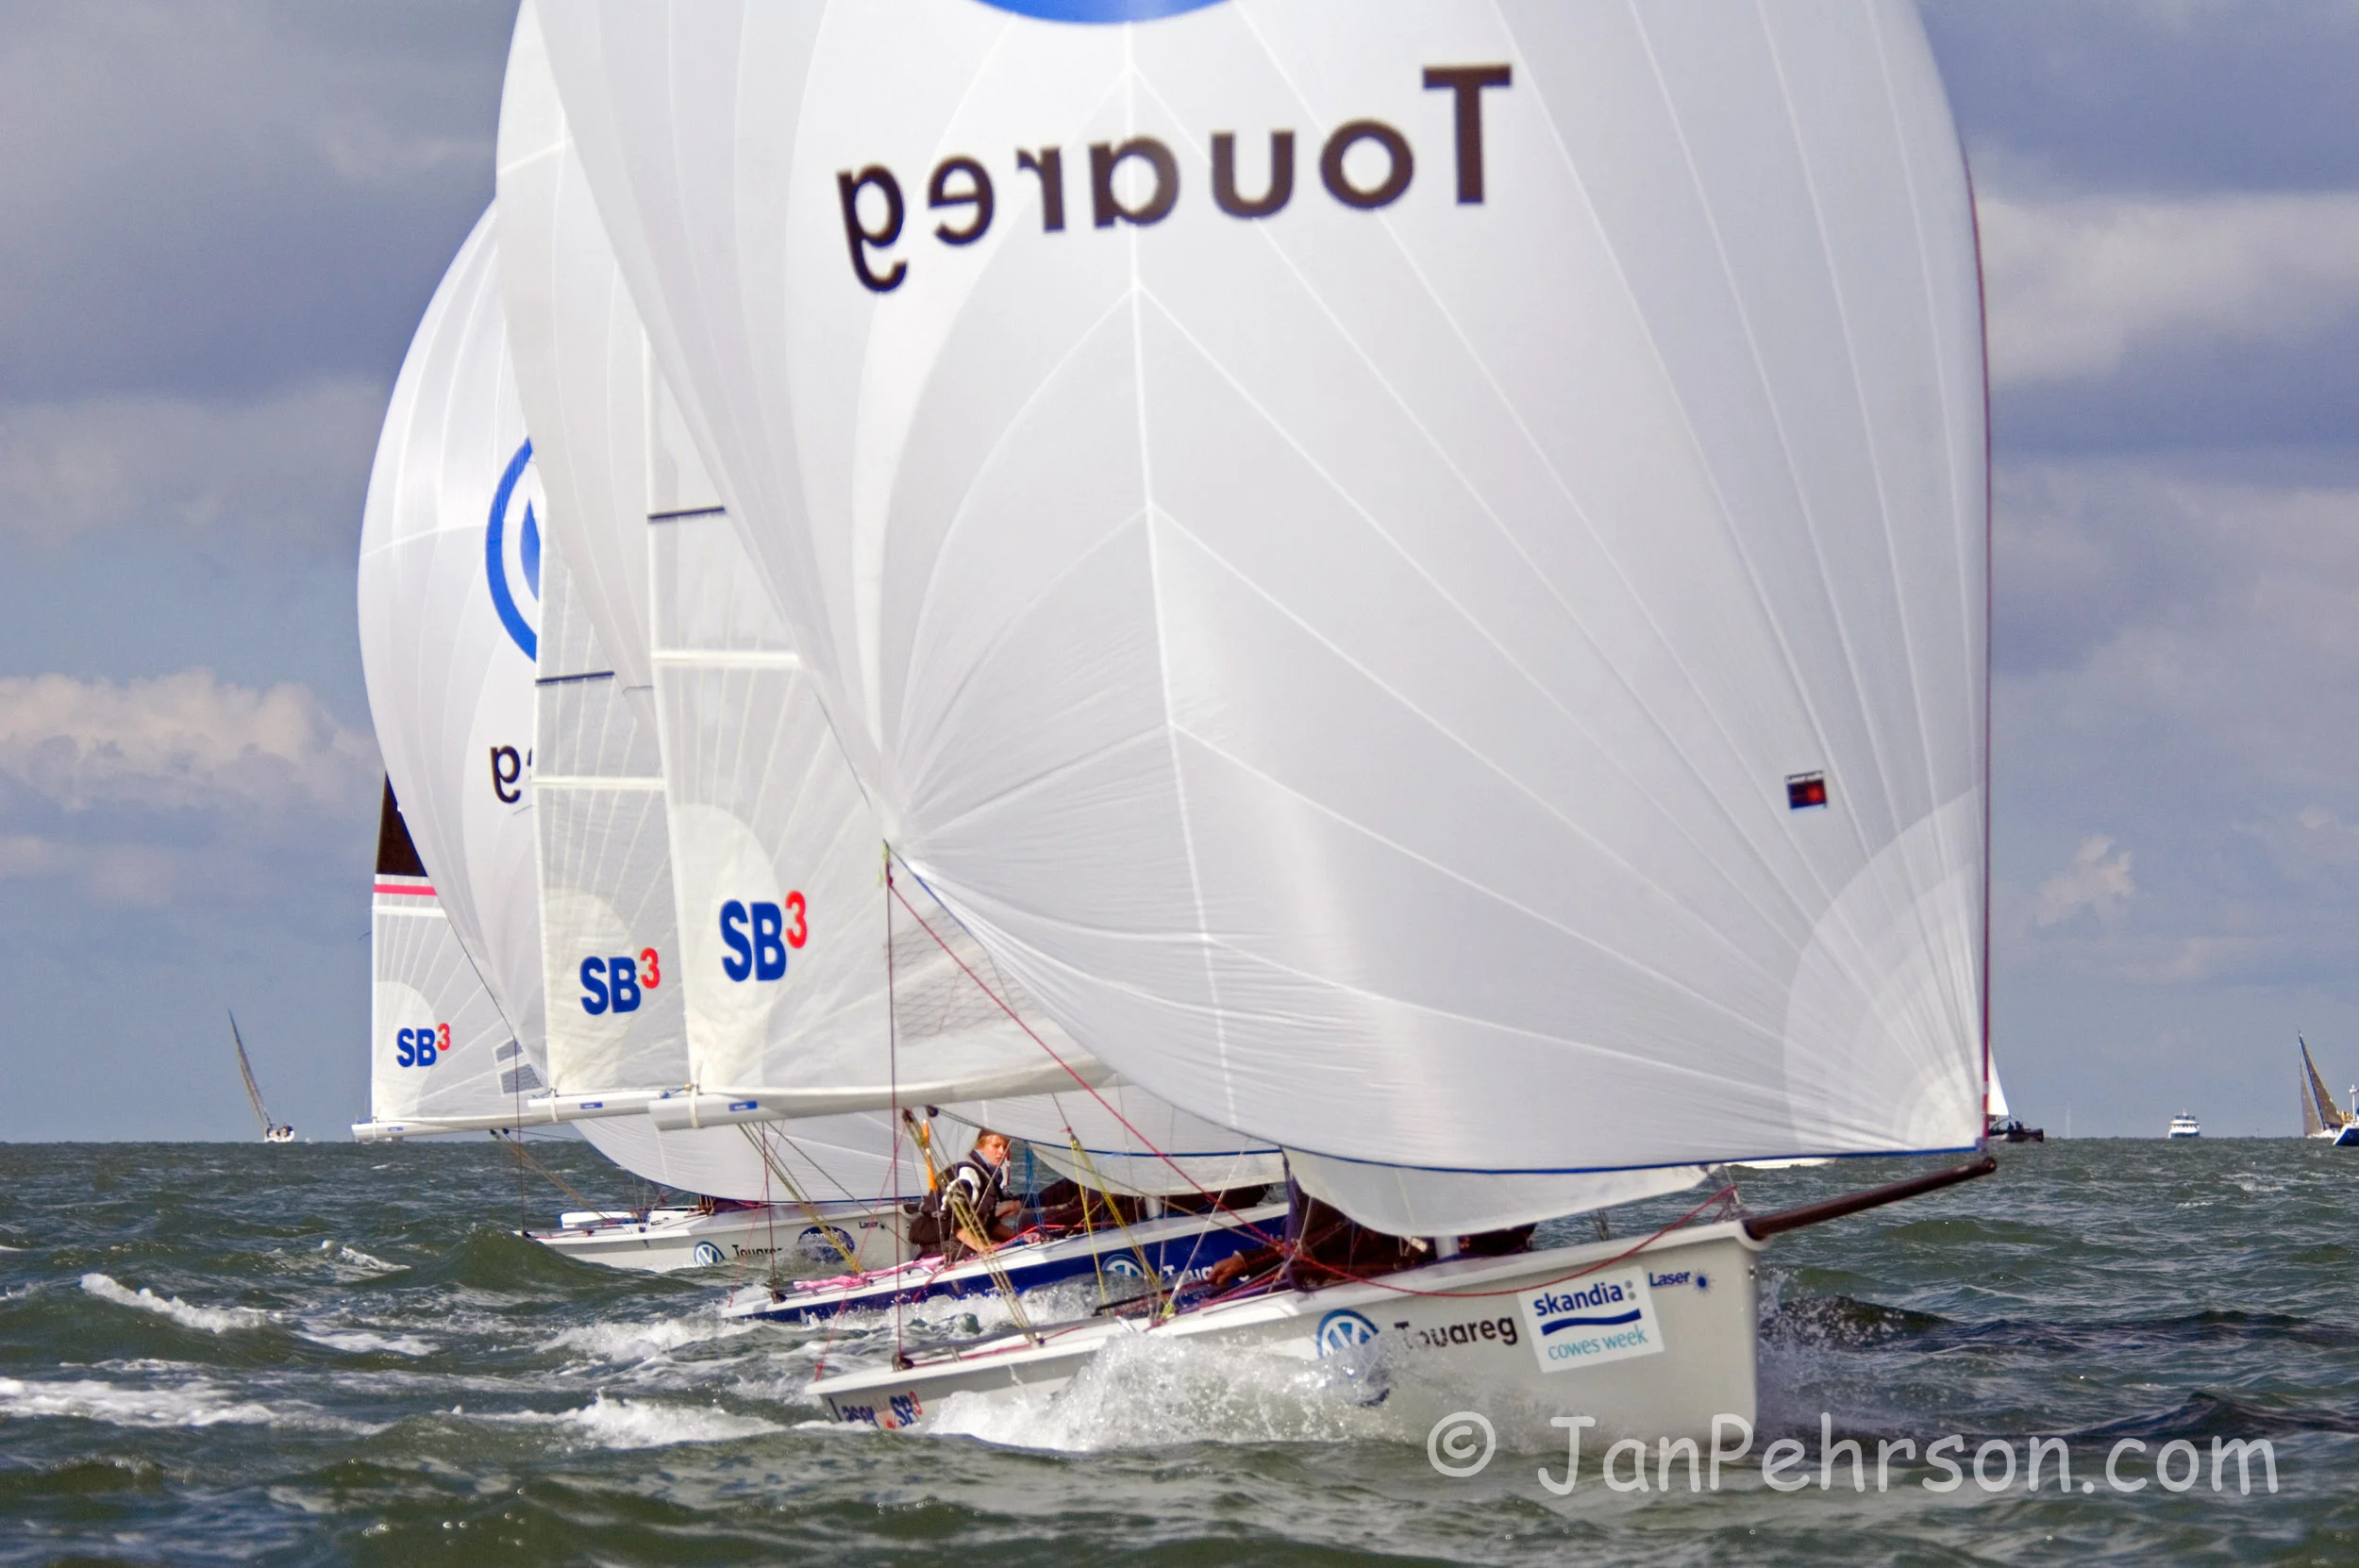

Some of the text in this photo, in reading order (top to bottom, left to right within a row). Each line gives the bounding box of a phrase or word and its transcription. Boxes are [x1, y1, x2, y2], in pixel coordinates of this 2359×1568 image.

[1648, 1271, 1691, 1287] Laser
[1548, 1324, 1648, 1360] cowes week
